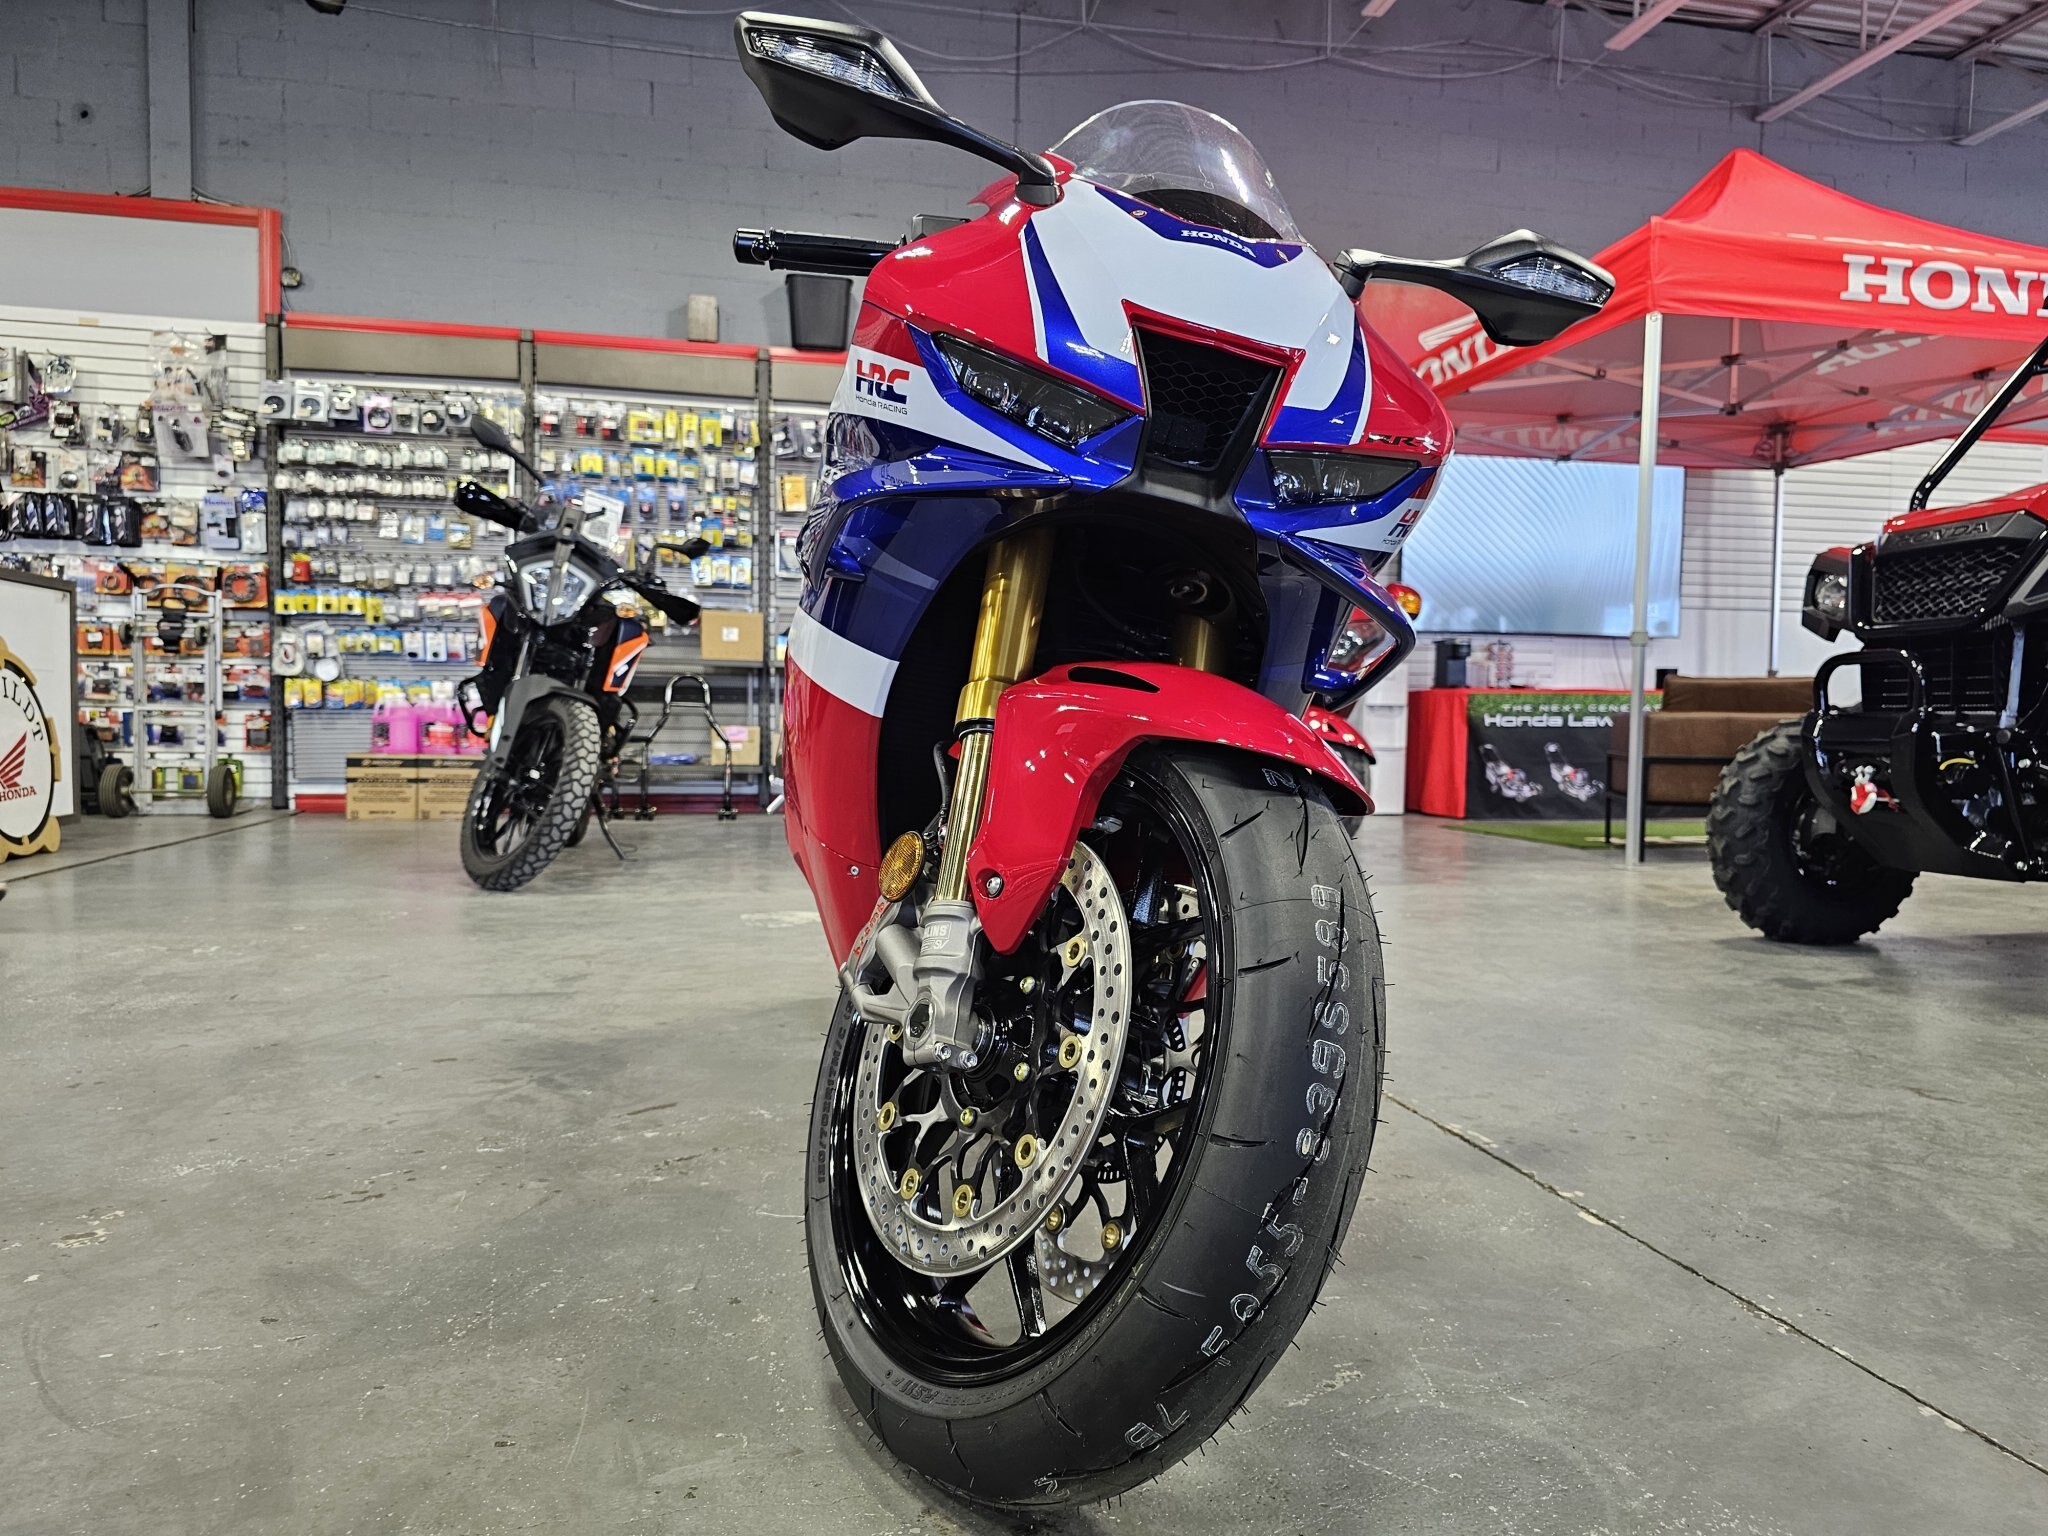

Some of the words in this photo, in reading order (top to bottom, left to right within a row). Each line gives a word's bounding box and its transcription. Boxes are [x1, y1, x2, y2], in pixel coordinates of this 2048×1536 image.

[1180, 229, 1257, 258] HONDA
[856, 359, 910, 405] HRC
[855, 394, 877, 408] Honda
[877, 401, 908, 416] RACING
[1500, 704, 1534, 713] THE
[1538, 704, 1582, 713] NEXT
[1483, 713, 1564, 728] Honda
[923, 924, 949, 938] LINS
